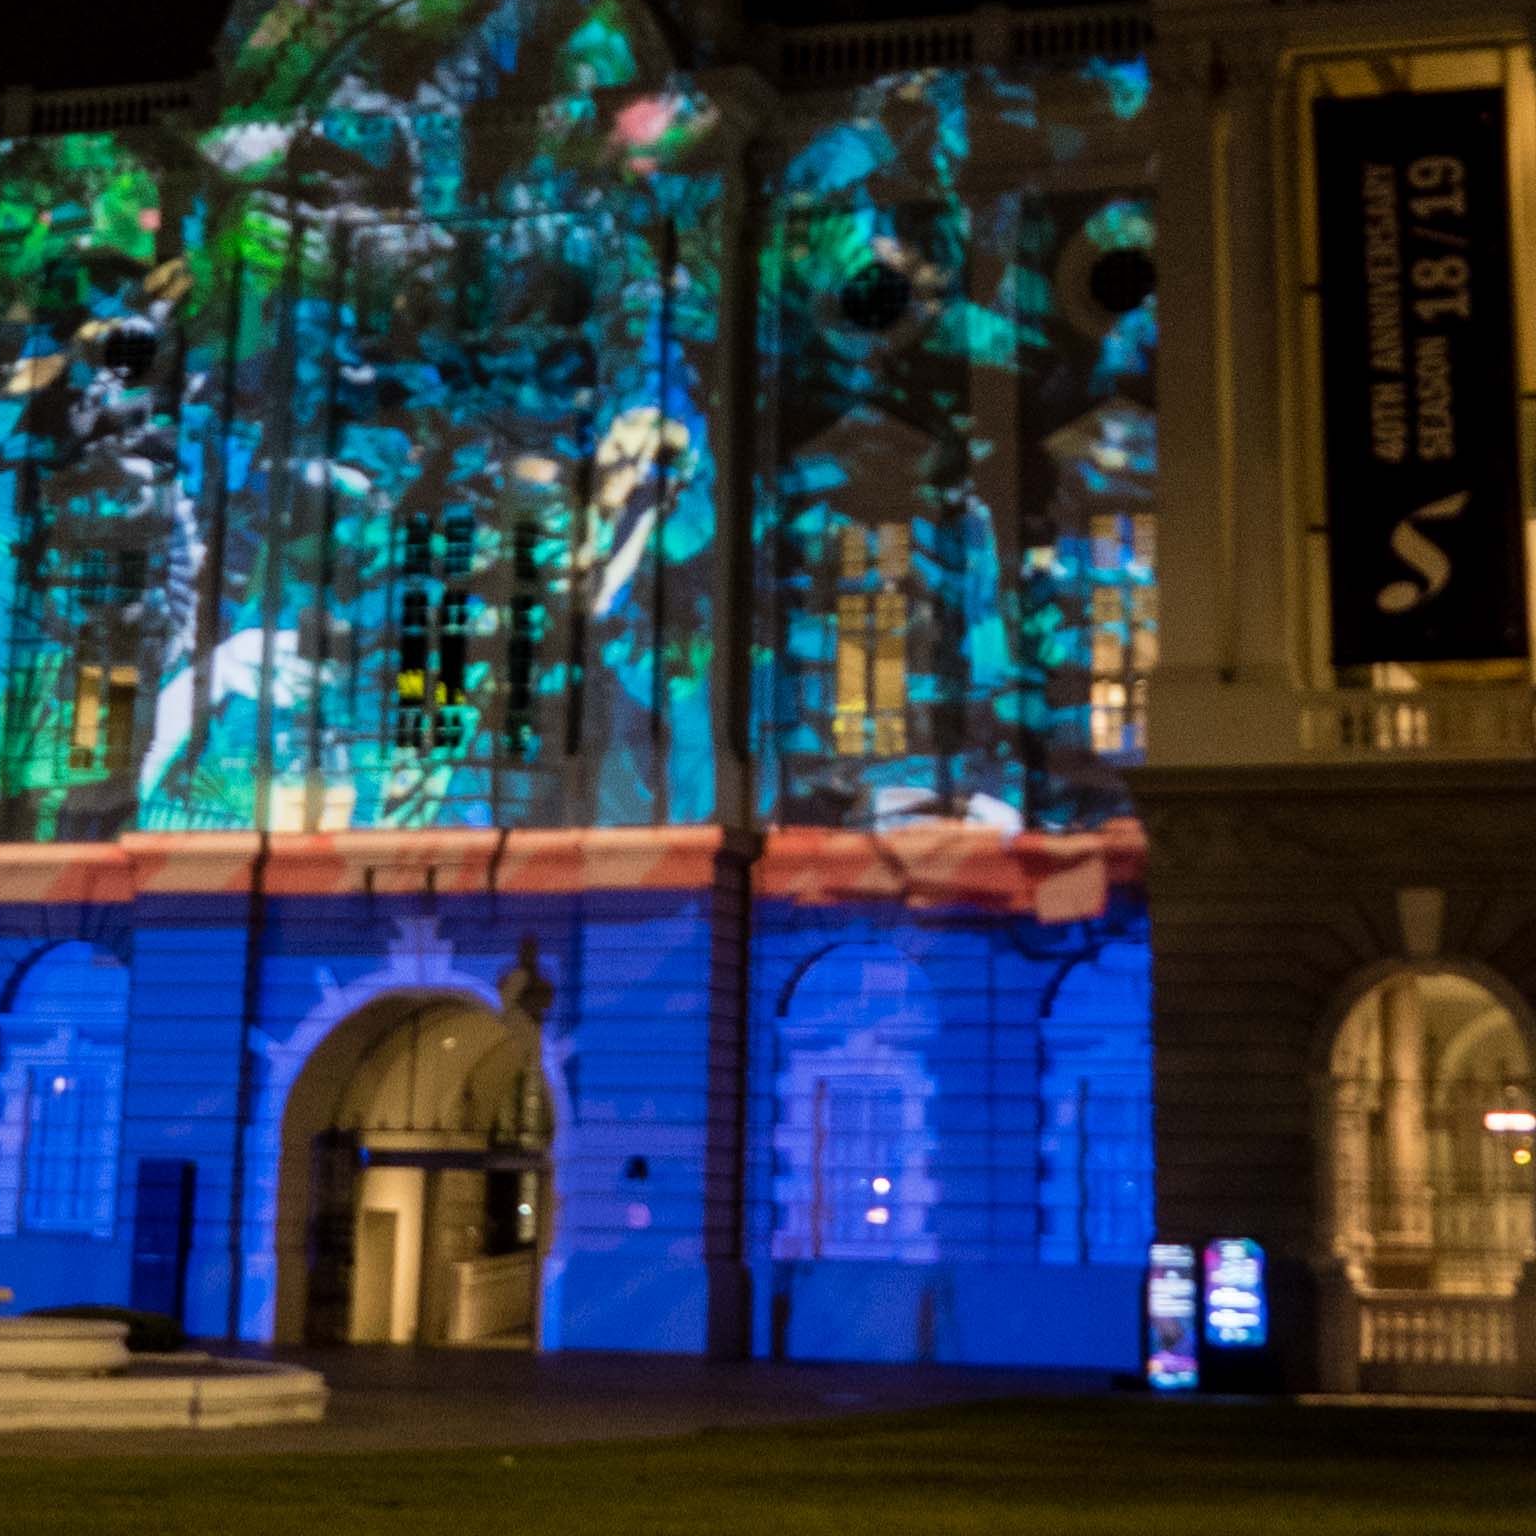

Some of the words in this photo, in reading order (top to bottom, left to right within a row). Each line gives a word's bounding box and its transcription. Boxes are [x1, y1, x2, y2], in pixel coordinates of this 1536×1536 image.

[1361, 160, 1405, 371] ANNIVERSARY
[1408, 154, 1472, 322] 18/19
[1413, 334, 1456, 462] SEASON
